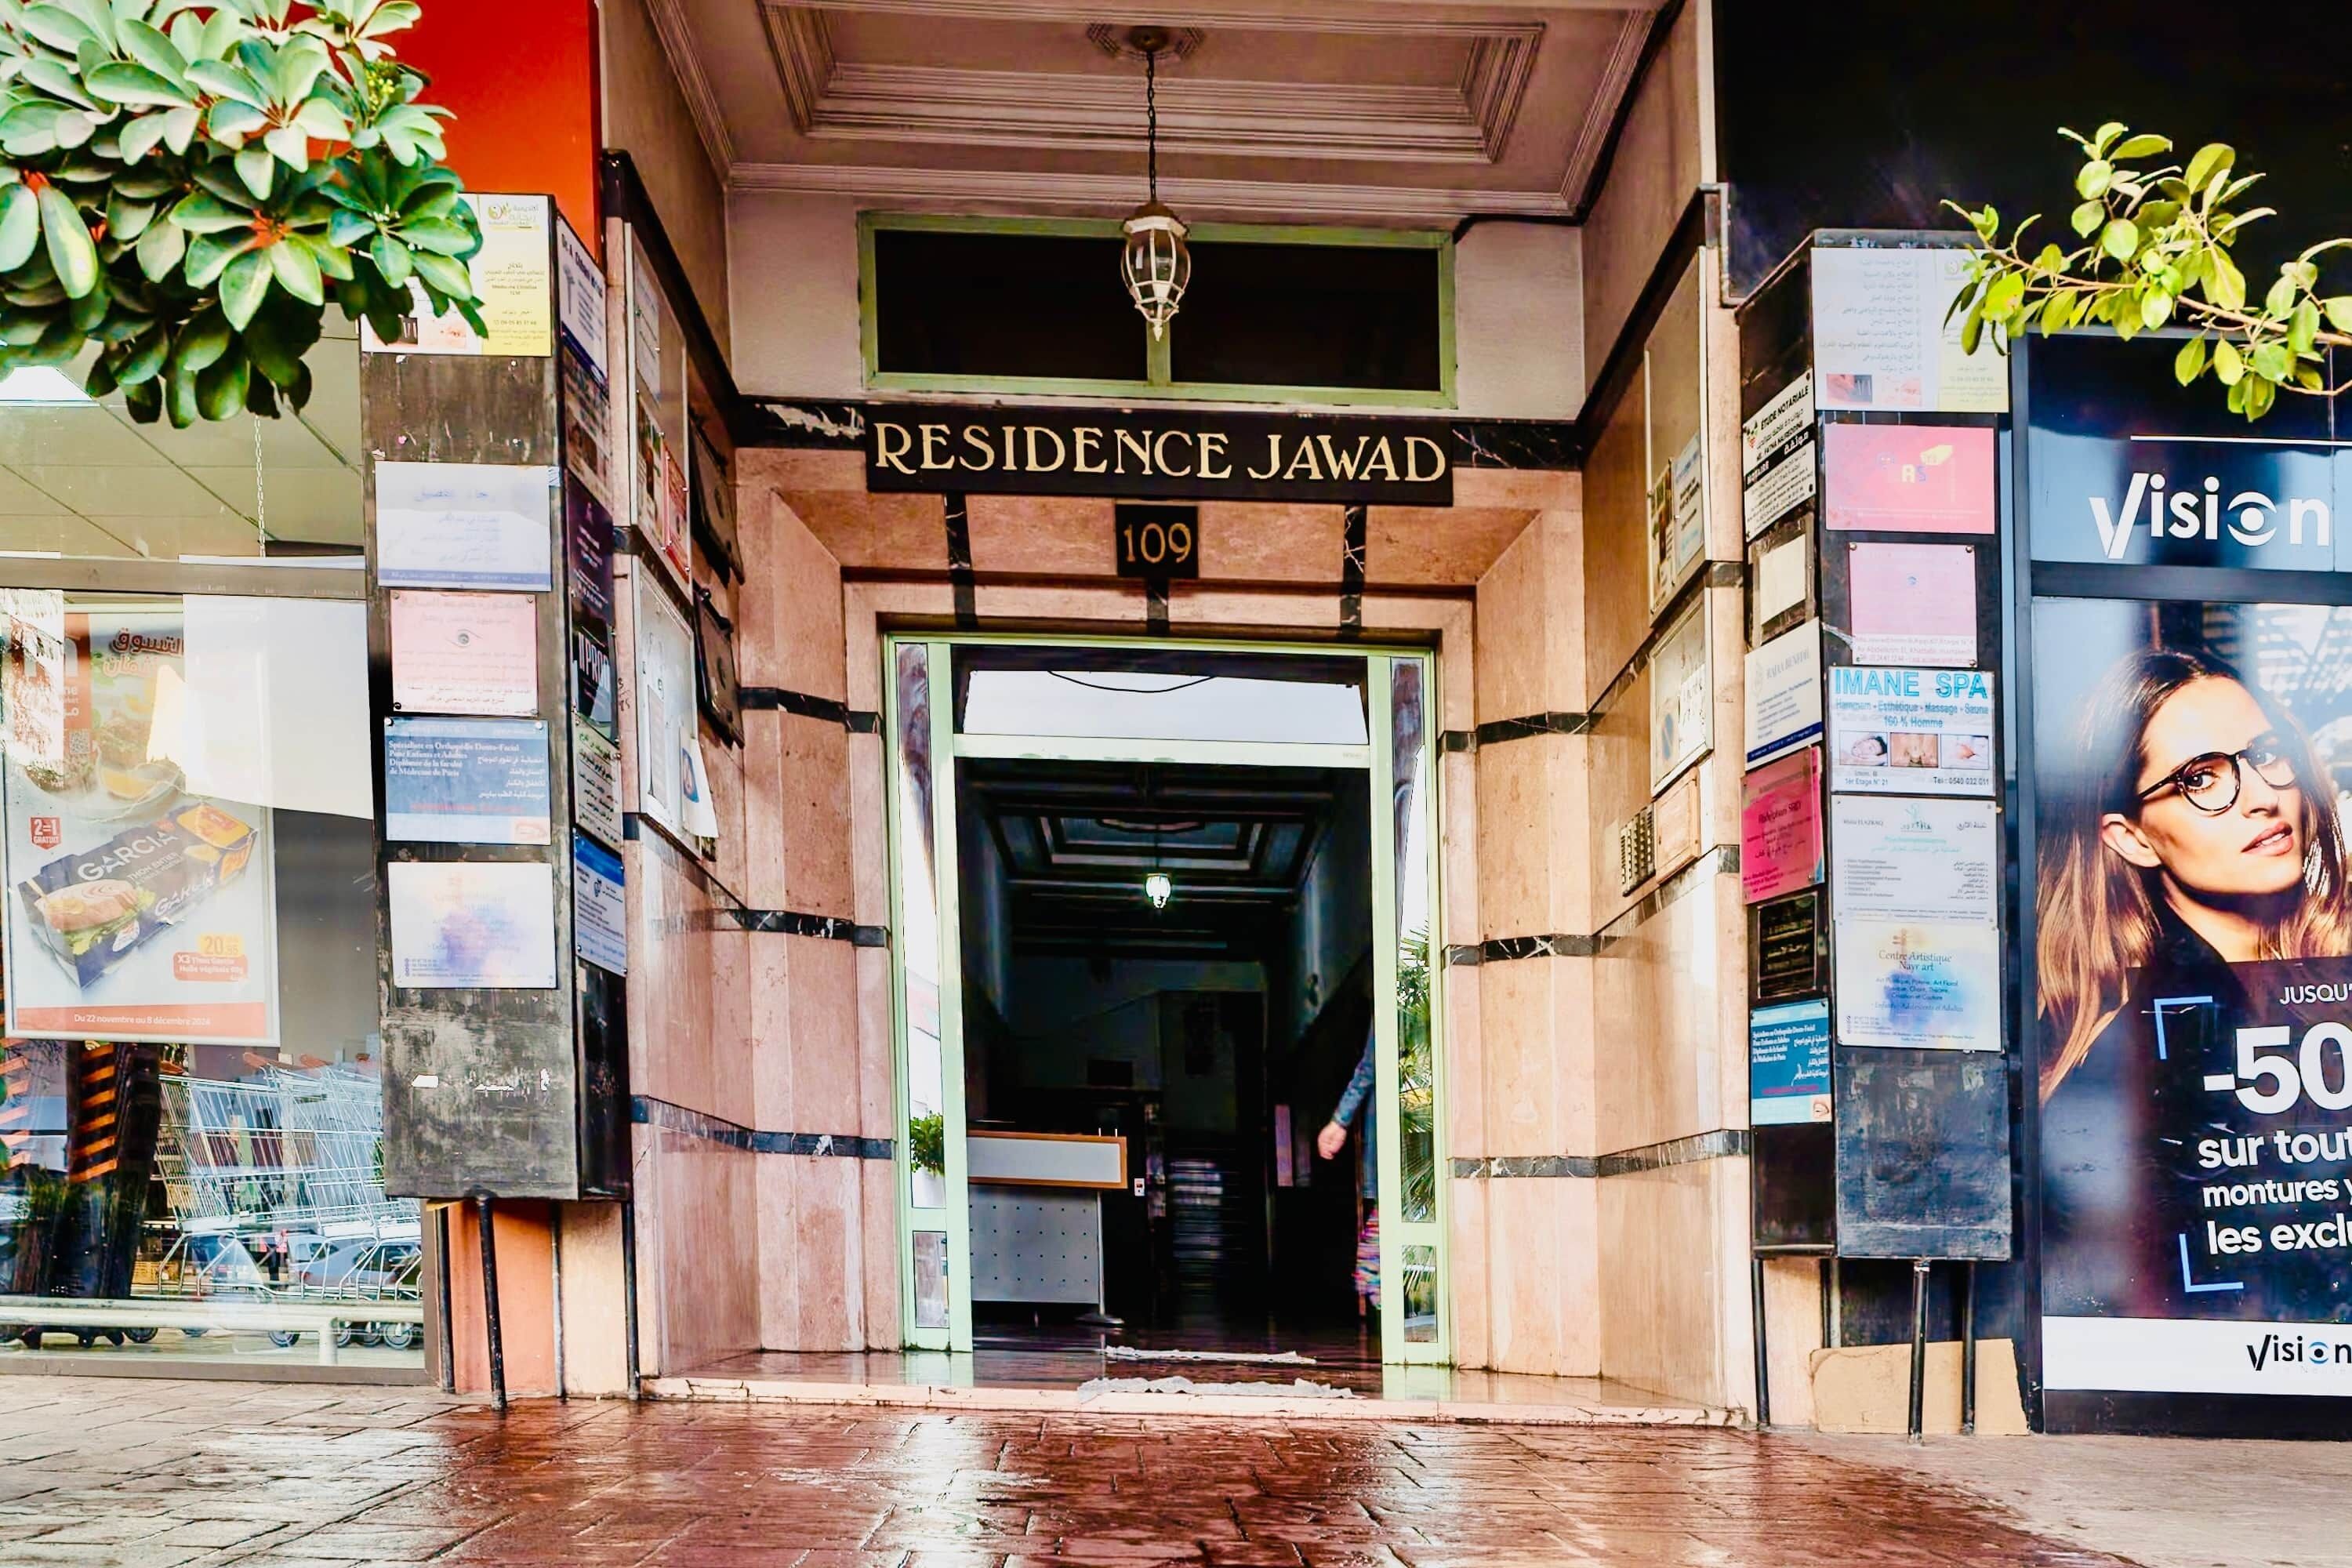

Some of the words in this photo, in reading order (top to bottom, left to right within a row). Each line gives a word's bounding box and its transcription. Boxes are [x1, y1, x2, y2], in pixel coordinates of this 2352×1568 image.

[1777, 385, 1809, 416] NOTARIALE
[874, 422, 1231, 480] RESIDENCE
[1247, 434, 1446, 482] JAWAD
[2089, 472, 2330, 559] Vision
[1124, 523, 1191, 564] 109
[1835, 669, 1920, 697] IMANE
[1936, 672, 1988, 699] SPA
[1911, 717, 1944, 728] Homme
[1925, 702, 1958, 716] Massage
[78, 830, 179, 882] GARCIA
[1878, 949, 1907, 960] Centre
[1908, 951, 1952, 965] Artistique
[1922, 963, 1934, 971] art
[74, 1014, 85, 1022] Du
[86, 1014, 96, 1022] 22
[96, 1014, 134, 1024] novembre
[154, 1015, 191, 1025] décembre
[2198, 1136, 2264, 1169] sur
[2203, 1178, 2339, 1207] montures
[2207, 1220, 2263, 1255] les
[2270, 1212, 2352, 1251] excl
[2246, 1334, 2352, 1371] Vision
